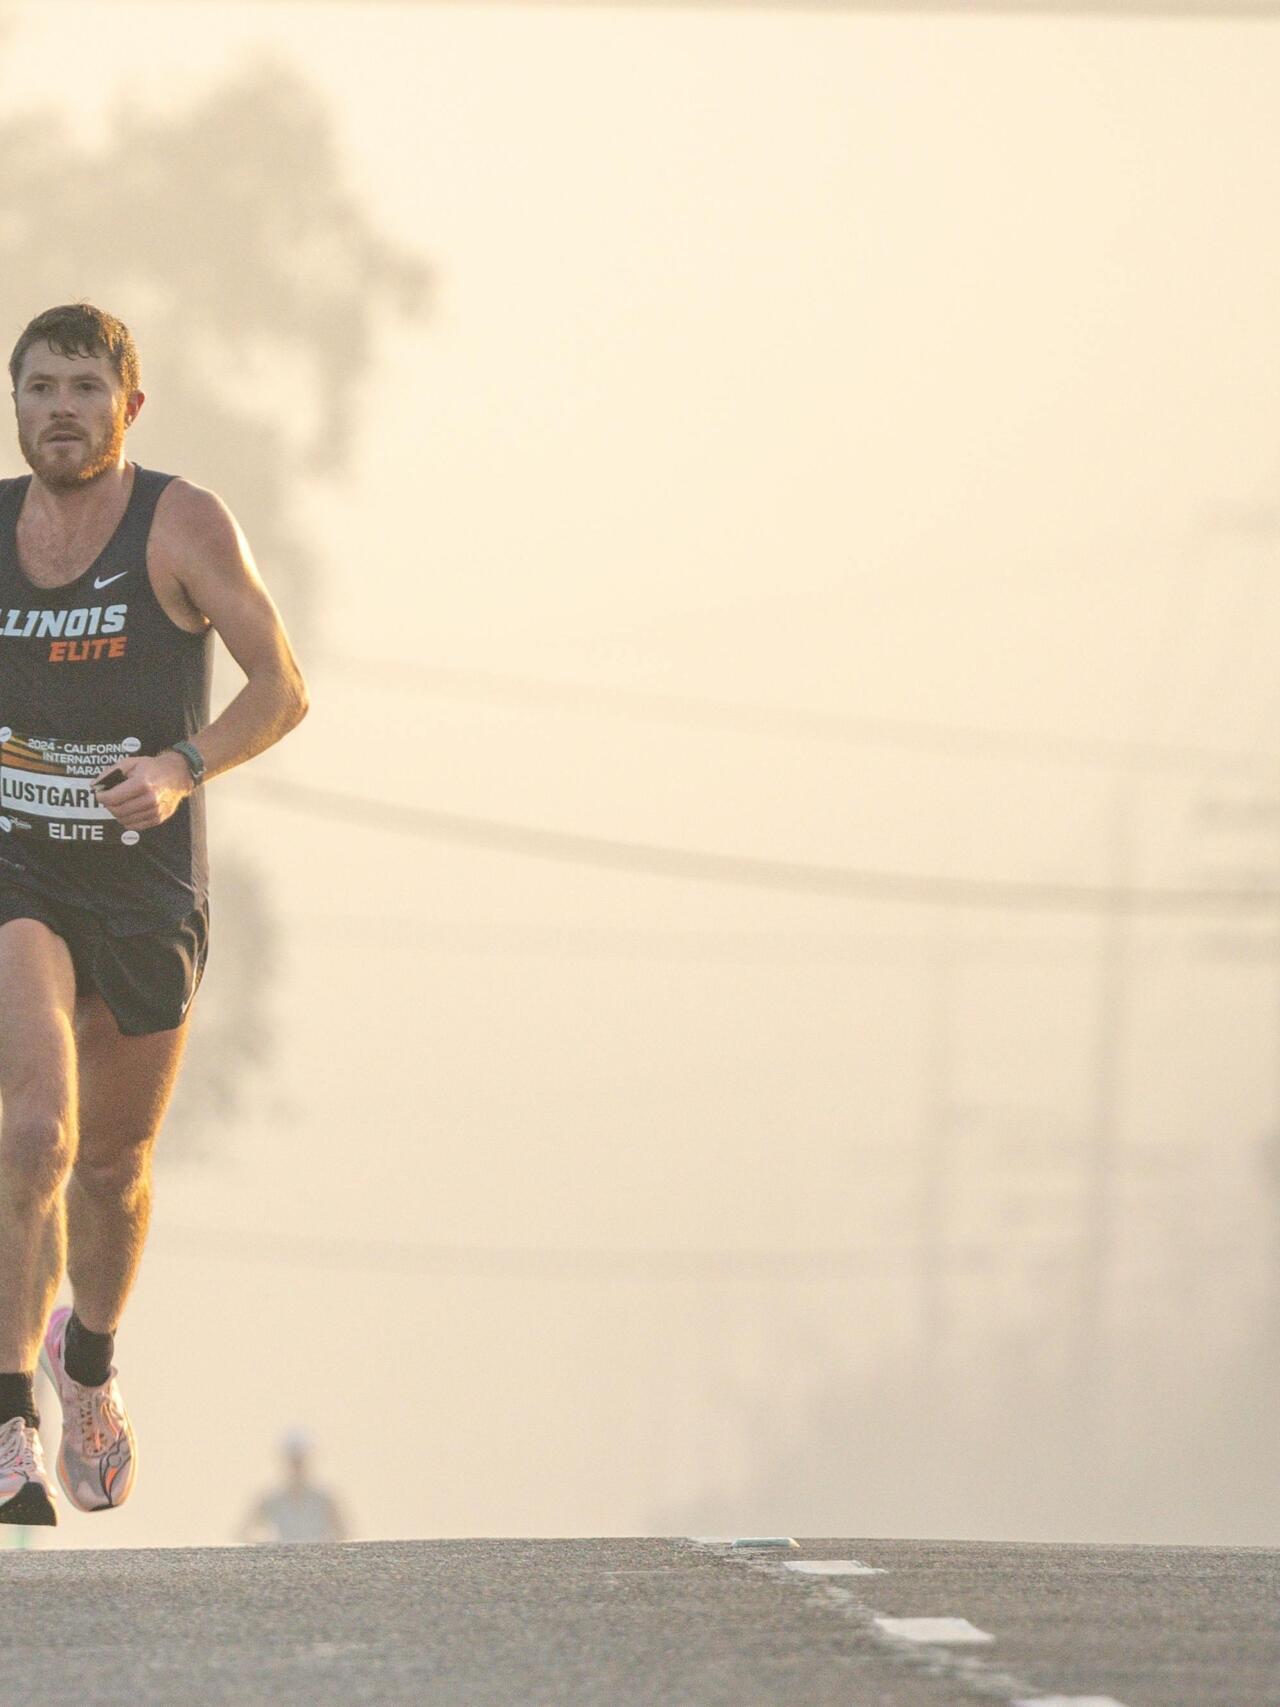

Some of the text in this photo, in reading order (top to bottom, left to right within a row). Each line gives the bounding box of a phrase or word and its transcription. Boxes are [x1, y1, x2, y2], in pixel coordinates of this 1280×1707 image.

[48, 637, 128, 662] ELITE
[28, 738, 55, 751] 2024
[64, 743, 125, 754] CALIFORNI
[48, 822, 104, 841] ELITE
